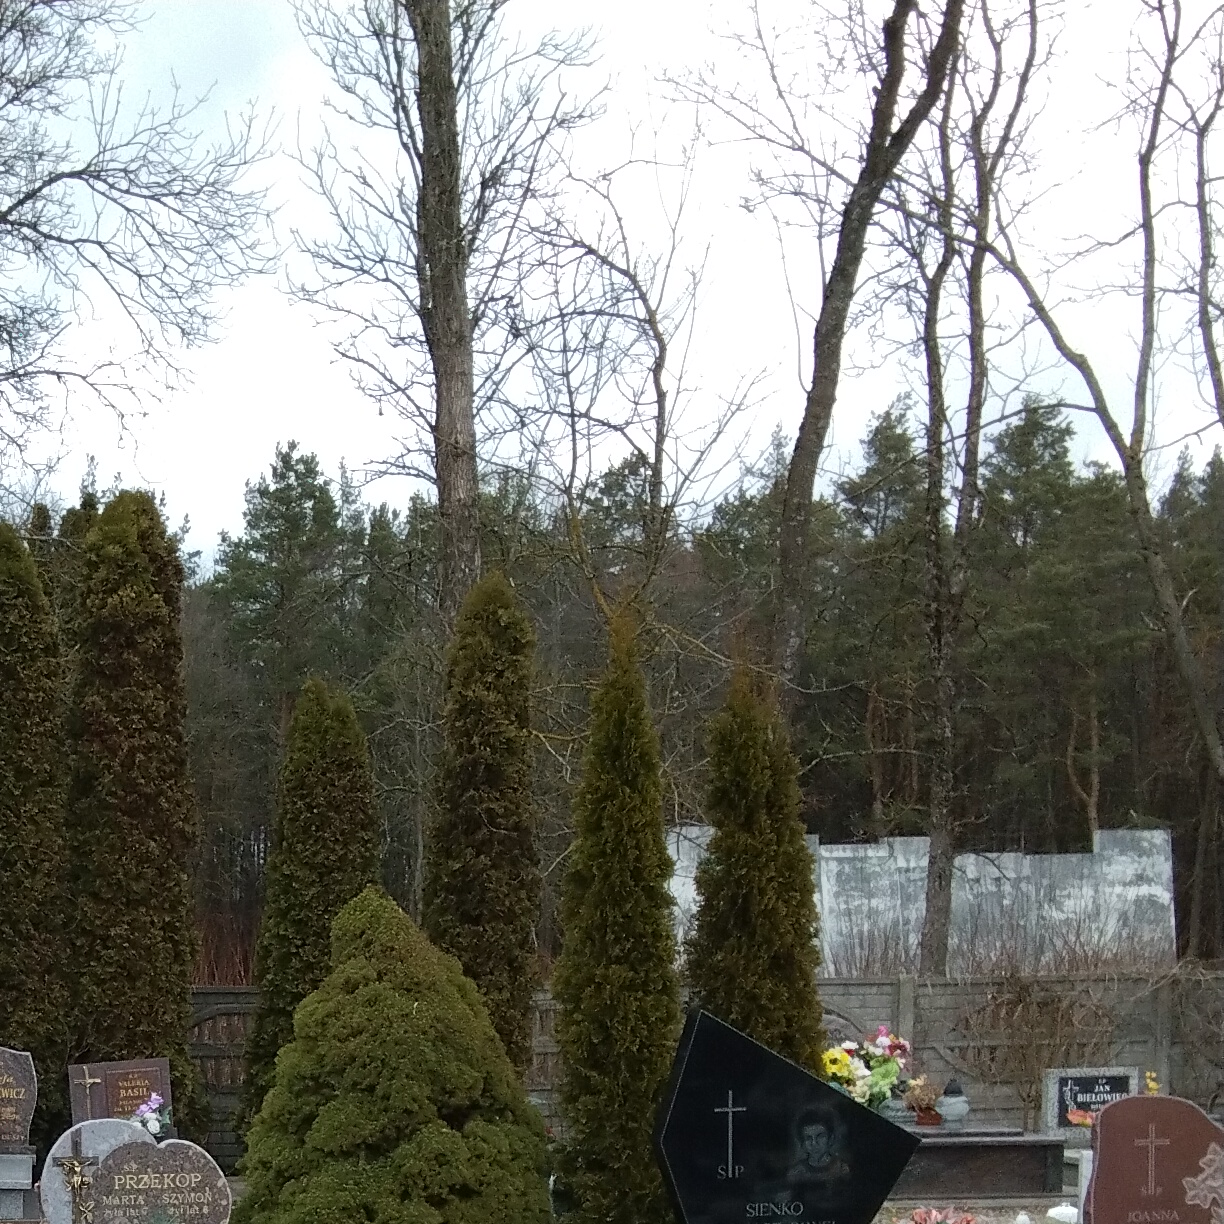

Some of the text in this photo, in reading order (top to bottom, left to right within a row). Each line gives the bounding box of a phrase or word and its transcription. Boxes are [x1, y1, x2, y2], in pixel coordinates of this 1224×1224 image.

[114, 1173, 202, 1190] PRZEKOP
[103, 1194, 145, 1206] MARTA
[1128, 1209, 1179, 1222] JOANNA
